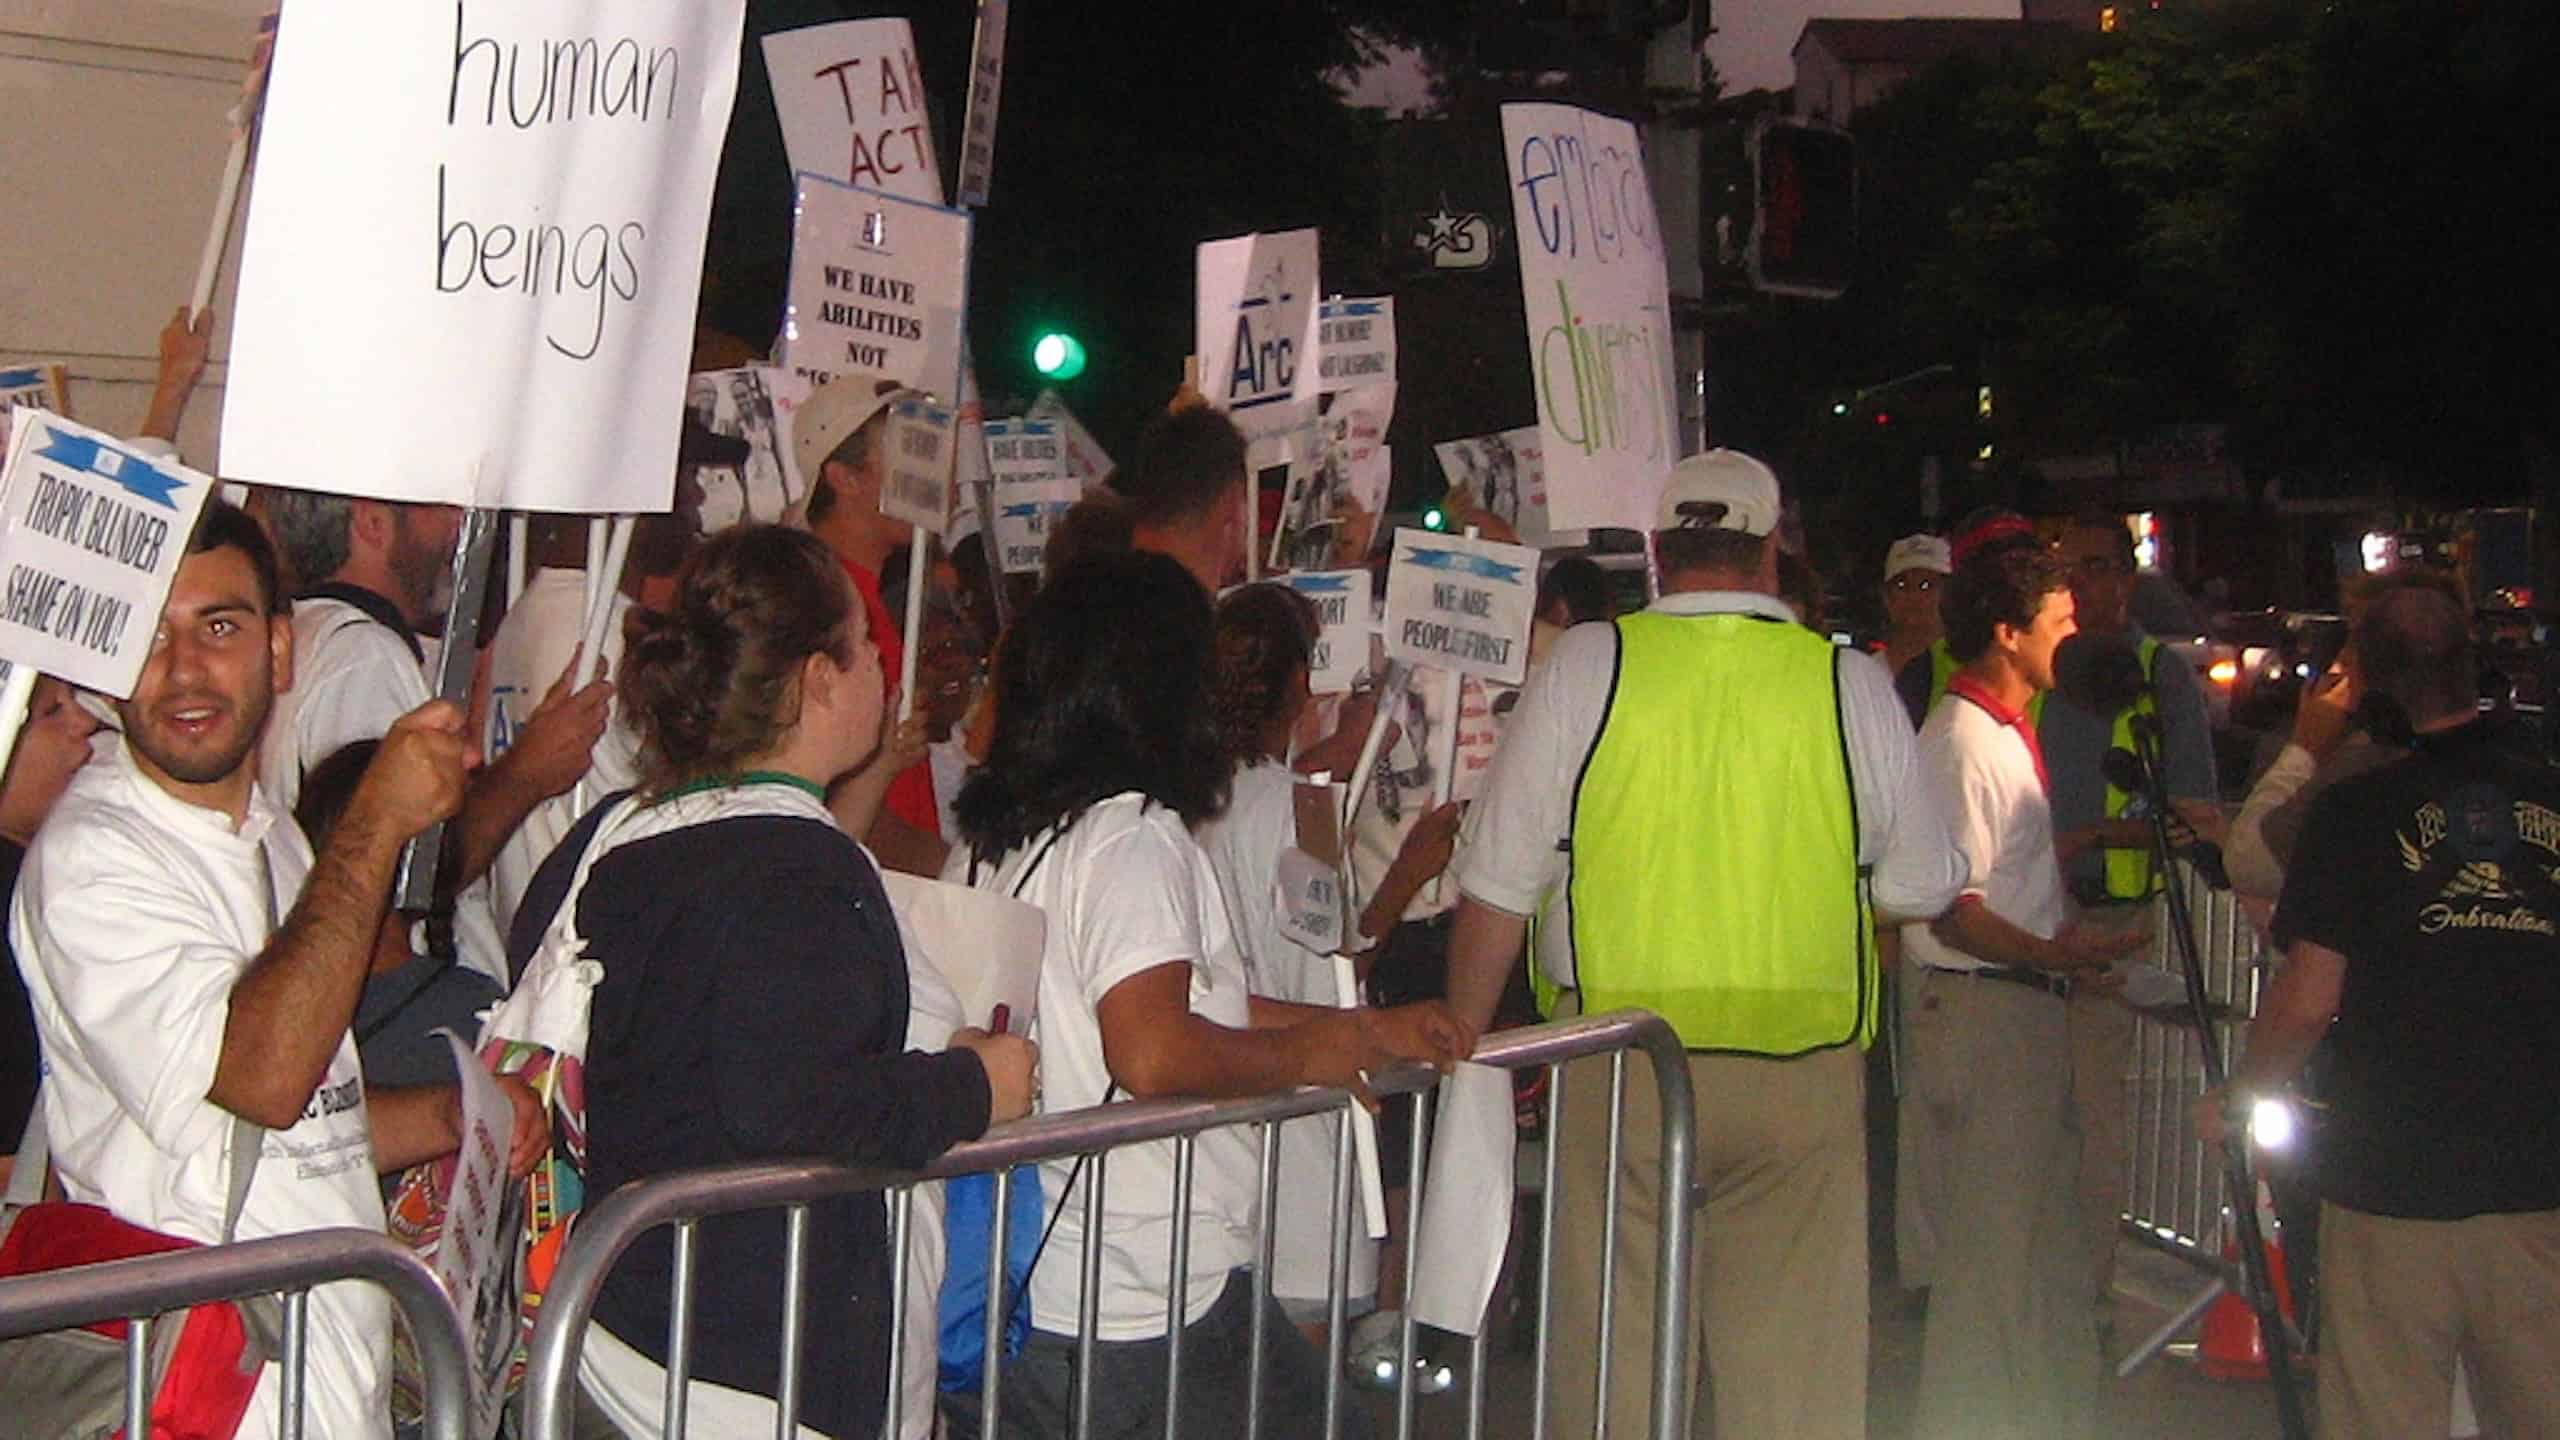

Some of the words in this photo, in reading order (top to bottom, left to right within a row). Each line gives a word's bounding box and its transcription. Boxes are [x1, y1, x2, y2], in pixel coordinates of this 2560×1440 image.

[448, 0, 679, 129] human
[850, 124, 926, 186] ACT
[437, 163, 646, 360] beings
[823, 264, 854, 292] WE
[859, 273, 916, 305] HAVE
[816, 300, 922, 341] ABILITIES
[845, 340, 888, 369] NOT
[1230, 314, 1293, 400] Arc
[24, 471, 94, 546] TROPIC
[84, 495, 168, 574] BLUNDER
[0, 563, 67, 634] SHAME
[55, 584, 90, 642] ON
[81, 591, 132, 657] YOU!
[1433, 582, 1457, 611] WE
[1460, 586, 1492, 618] ARE
[1401, 618, 1460, 654] PEOPLE
[1458, 628, 1513, 665] FIRST
